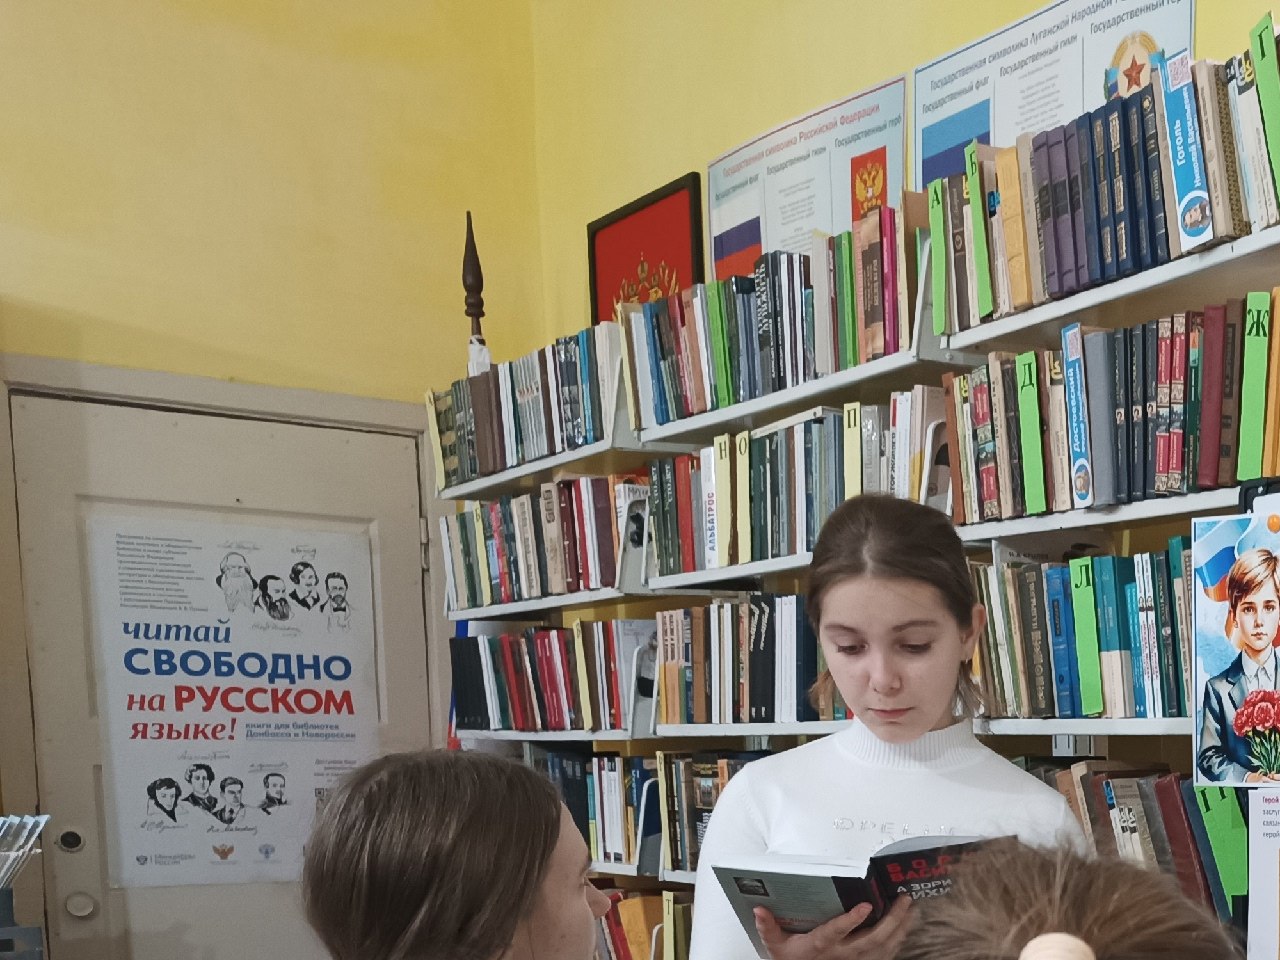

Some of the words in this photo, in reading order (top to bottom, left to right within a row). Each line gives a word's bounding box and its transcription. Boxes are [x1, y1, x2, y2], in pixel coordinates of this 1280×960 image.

[1174, 119, 1186, 167] Гоголь
[1247, 308, 1269, 338] Ж
[1021, 362, 1035, 394] Д
[847, 408, 857, 429] П
[1067, 368, 1081, 453] Достоевский
[707, 492, 717, 552] АЛЬБАТРОС
[1075, 564, 1091, 589] Л
[122, 618, 232, 644] читай
[123, 648, 352, 685] СВОБОДНО
[126, 692, 166, 713] на
[175, 685, 355, 716] РУССКОМ
[129, 717, 238, 742] языке!
[897, 885, 907, 893] А
[911, 878, 953, 890] ЗОРИ
